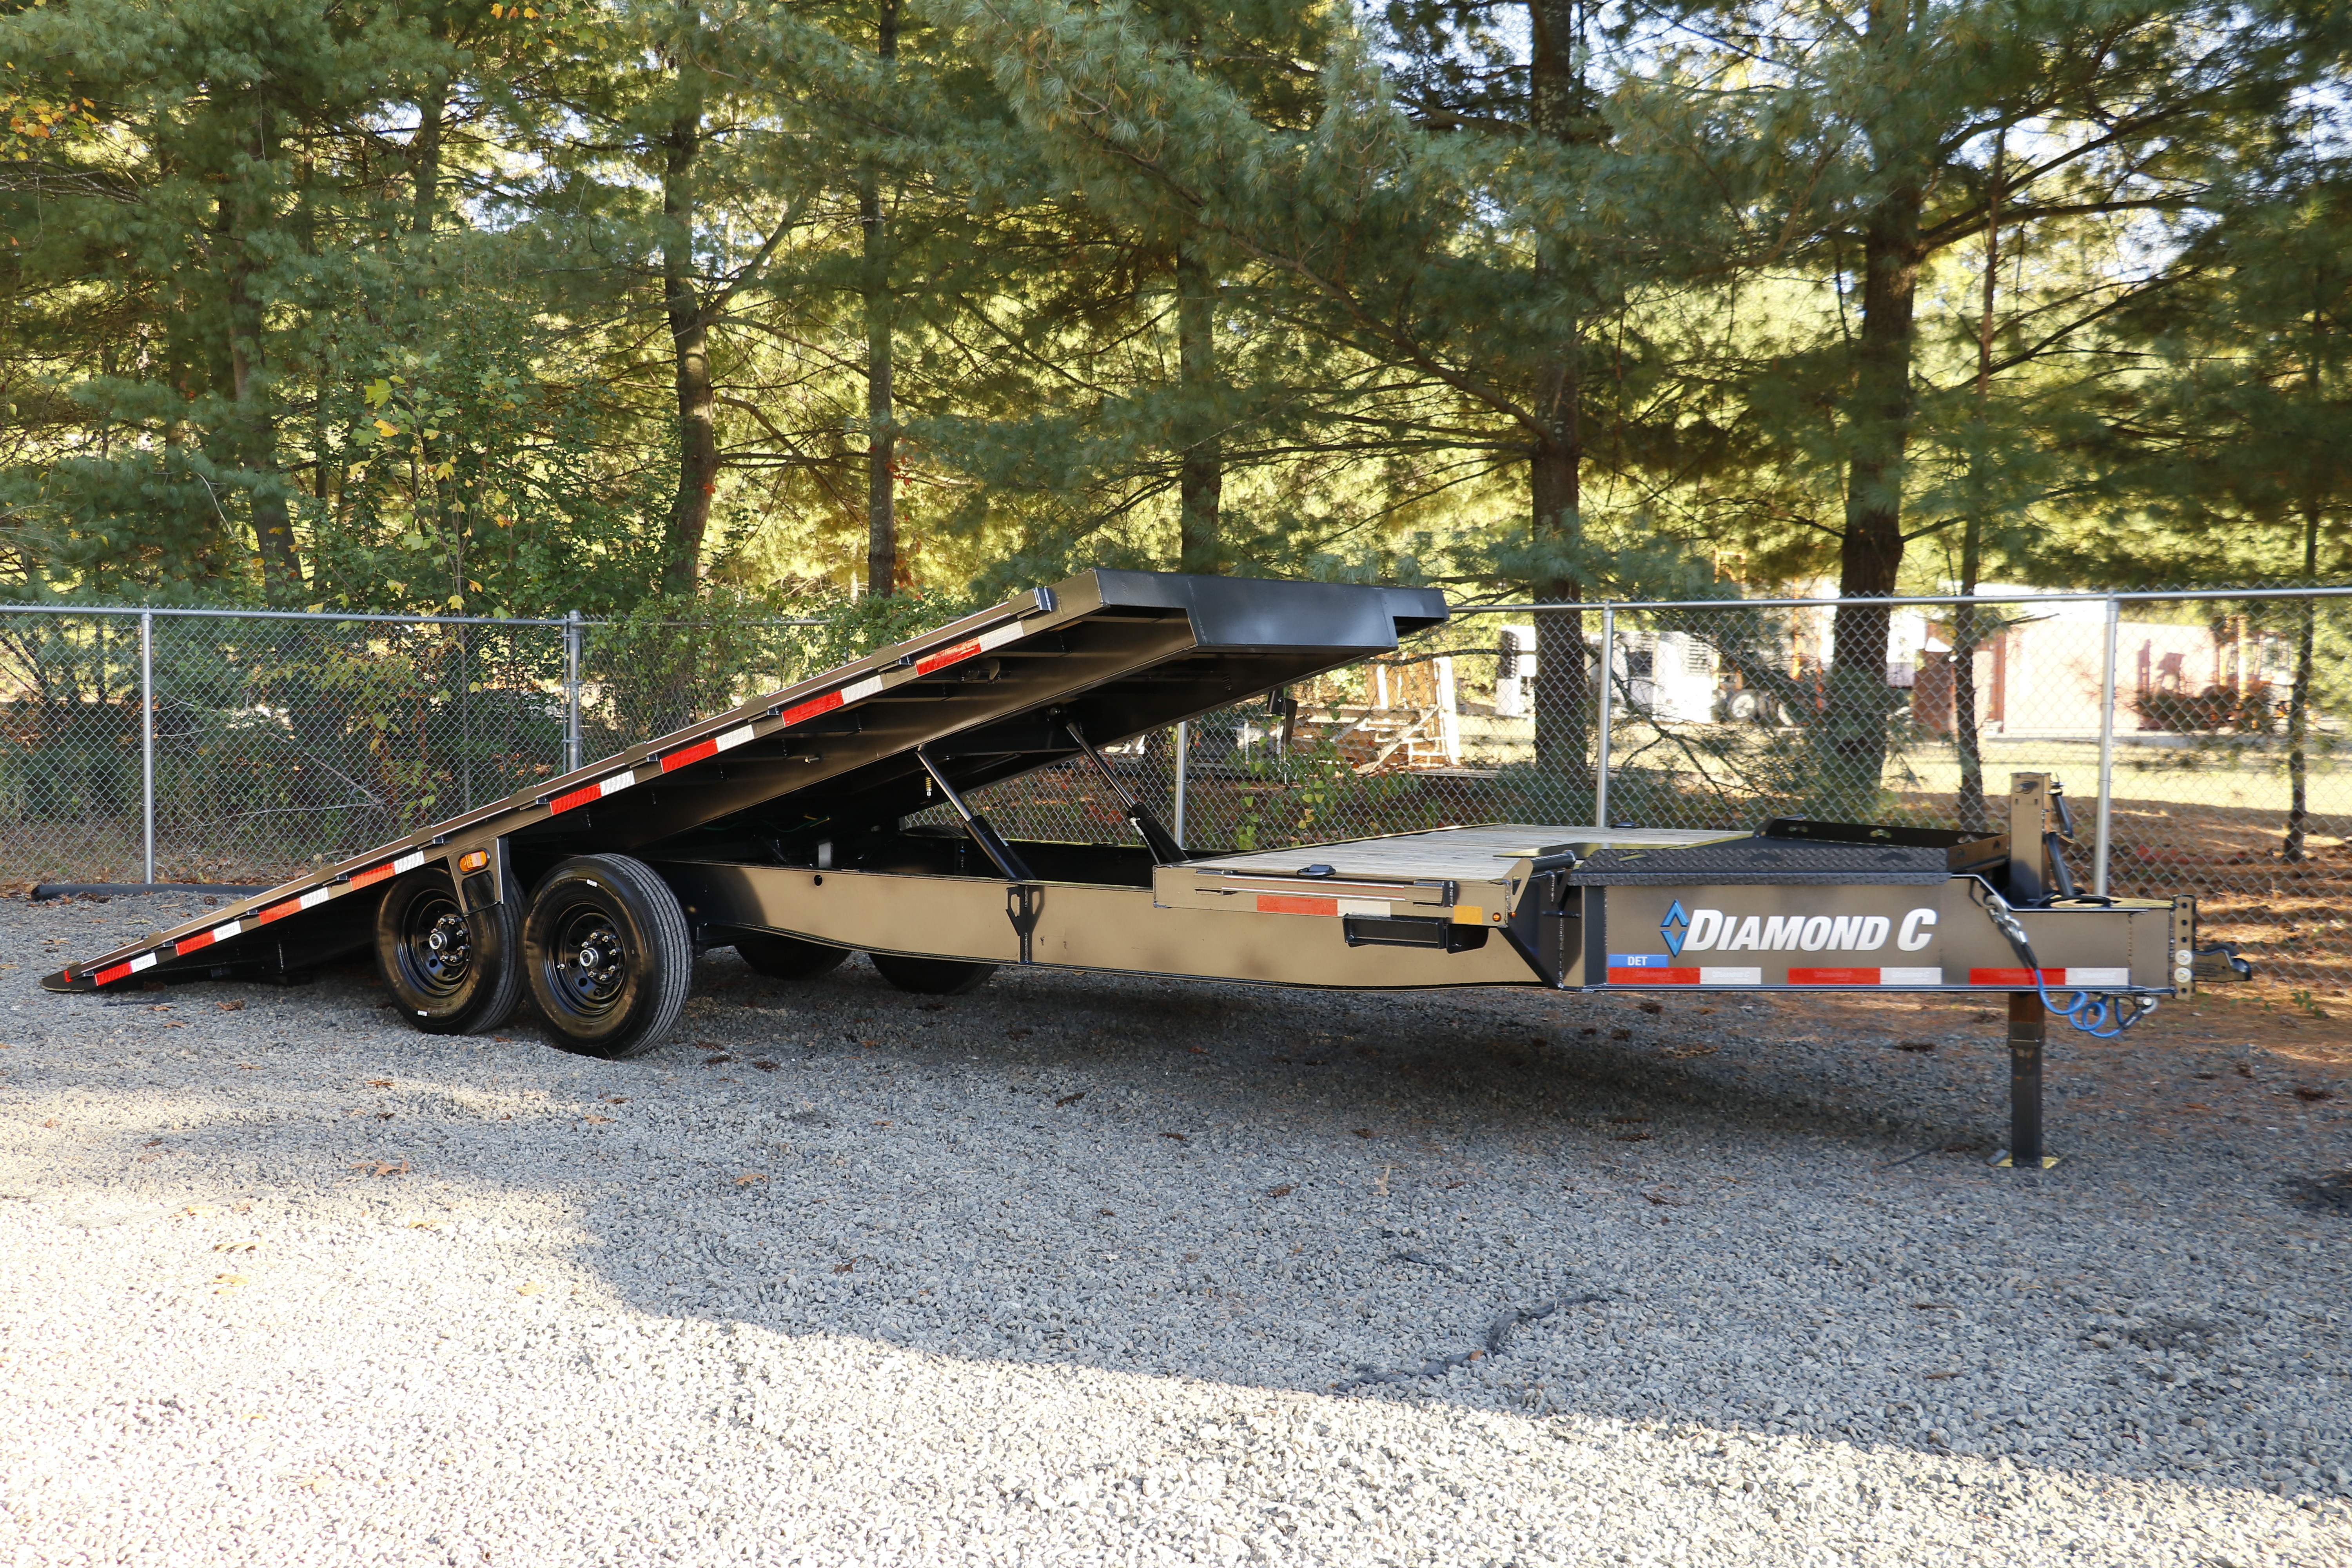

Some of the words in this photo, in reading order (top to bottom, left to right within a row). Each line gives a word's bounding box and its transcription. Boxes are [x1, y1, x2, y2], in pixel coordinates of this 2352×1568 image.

[1681, 909, 1890, 951] DIAMOND
[1897, 908, 1937, 951] C
[1628, 956, 1648, 966] DET
